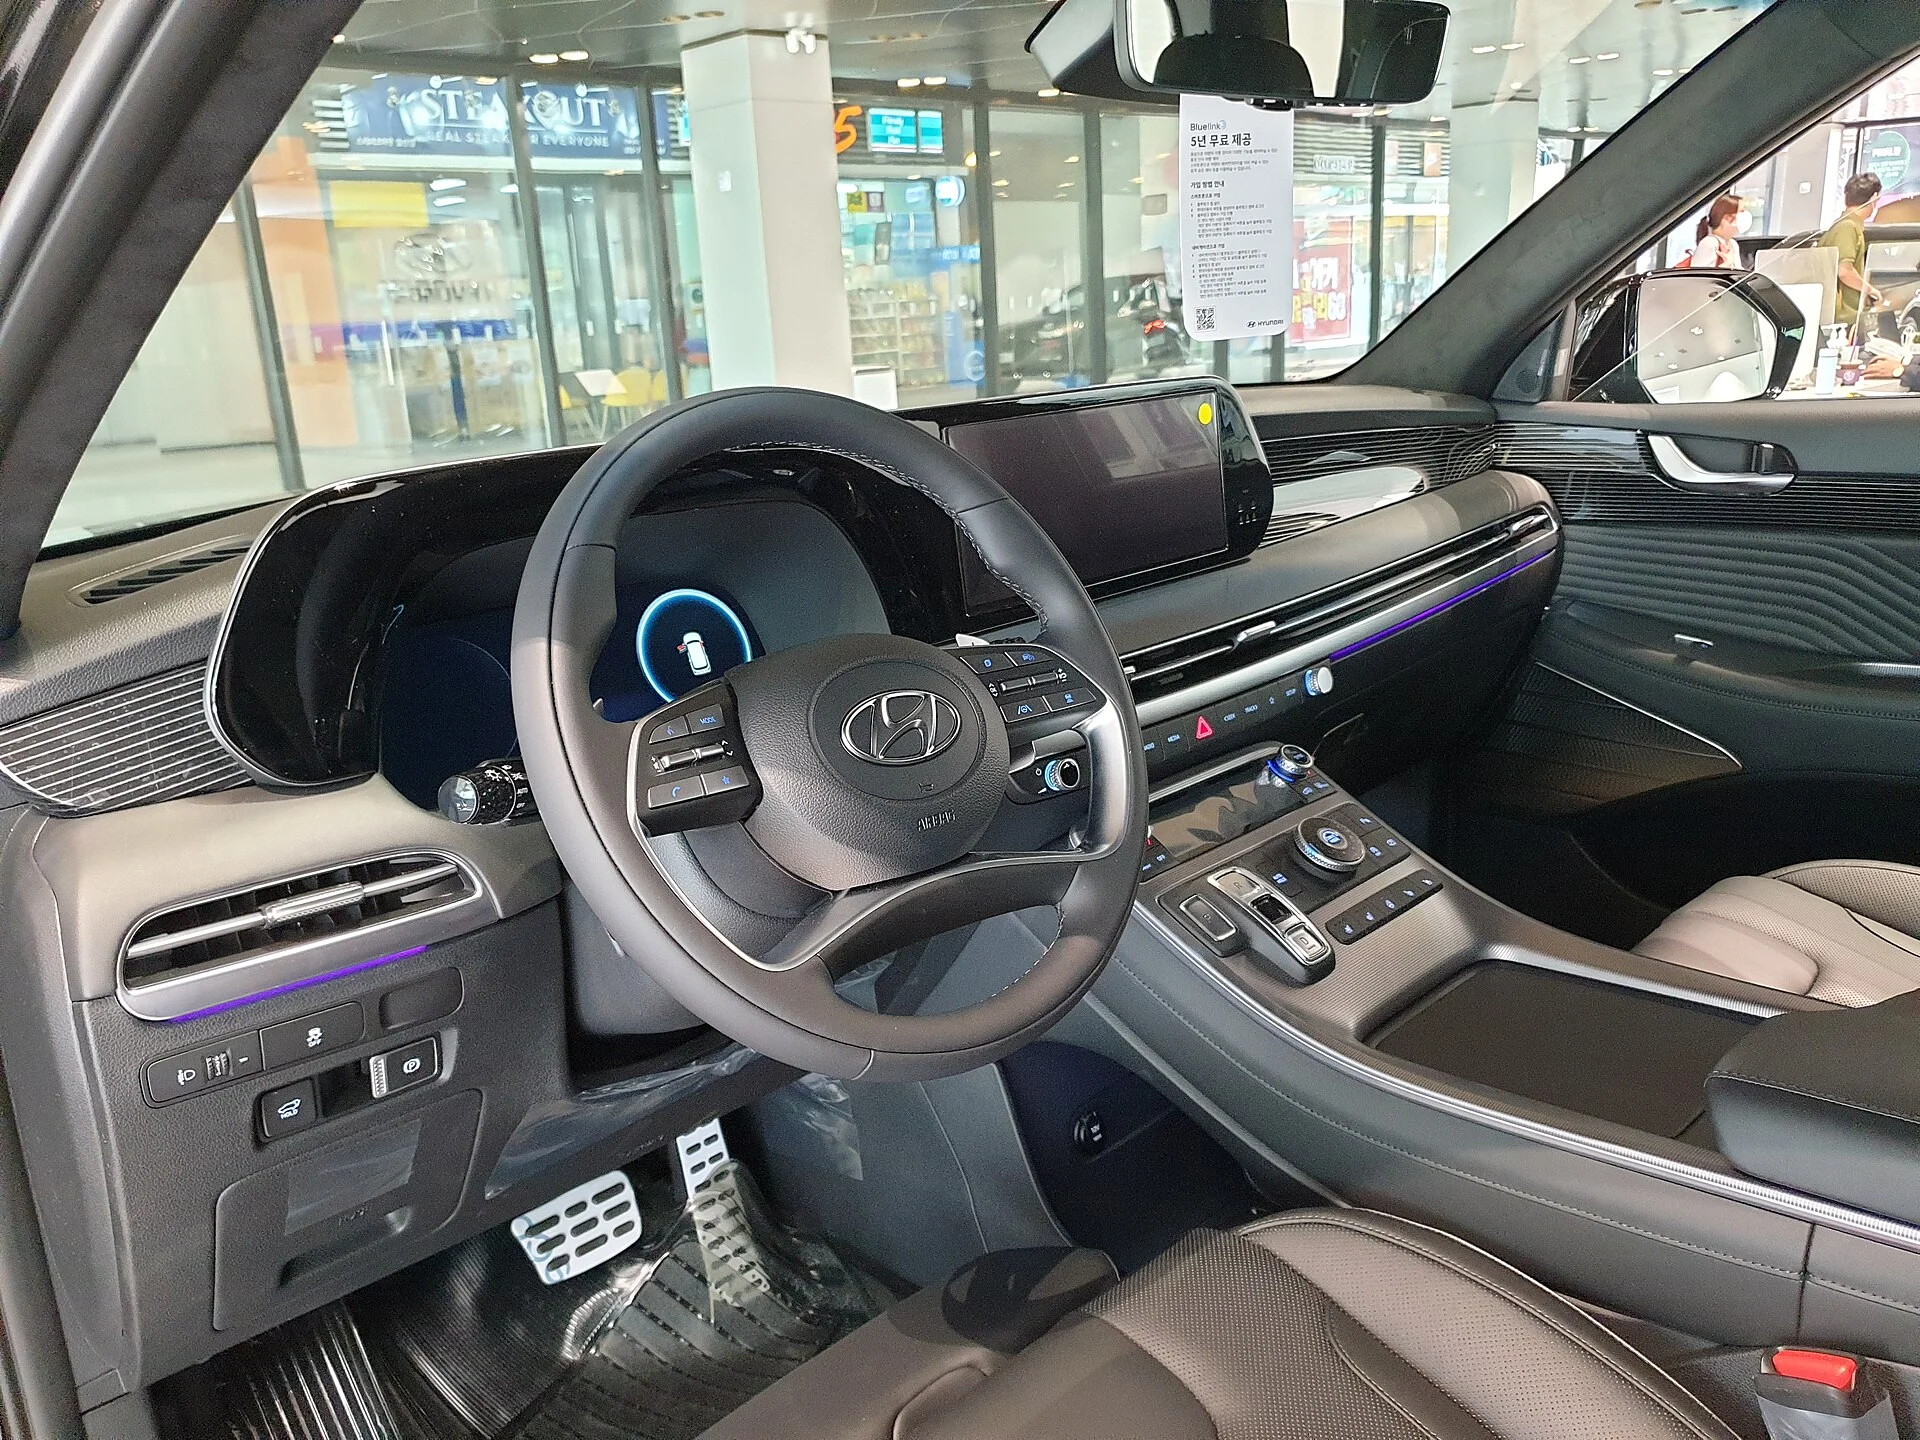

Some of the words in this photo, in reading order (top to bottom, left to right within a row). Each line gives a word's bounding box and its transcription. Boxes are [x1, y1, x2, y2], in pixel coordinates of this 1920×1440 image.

[1190, 122, 1221, 131] Bluelink
[1190, 134, 1206, 148] 5년
[1209, 134, 1230, 147] 무료
[1232, 133, 1252, 146] 제공
[1257, 319, 1284, 327] HYUNDAI
